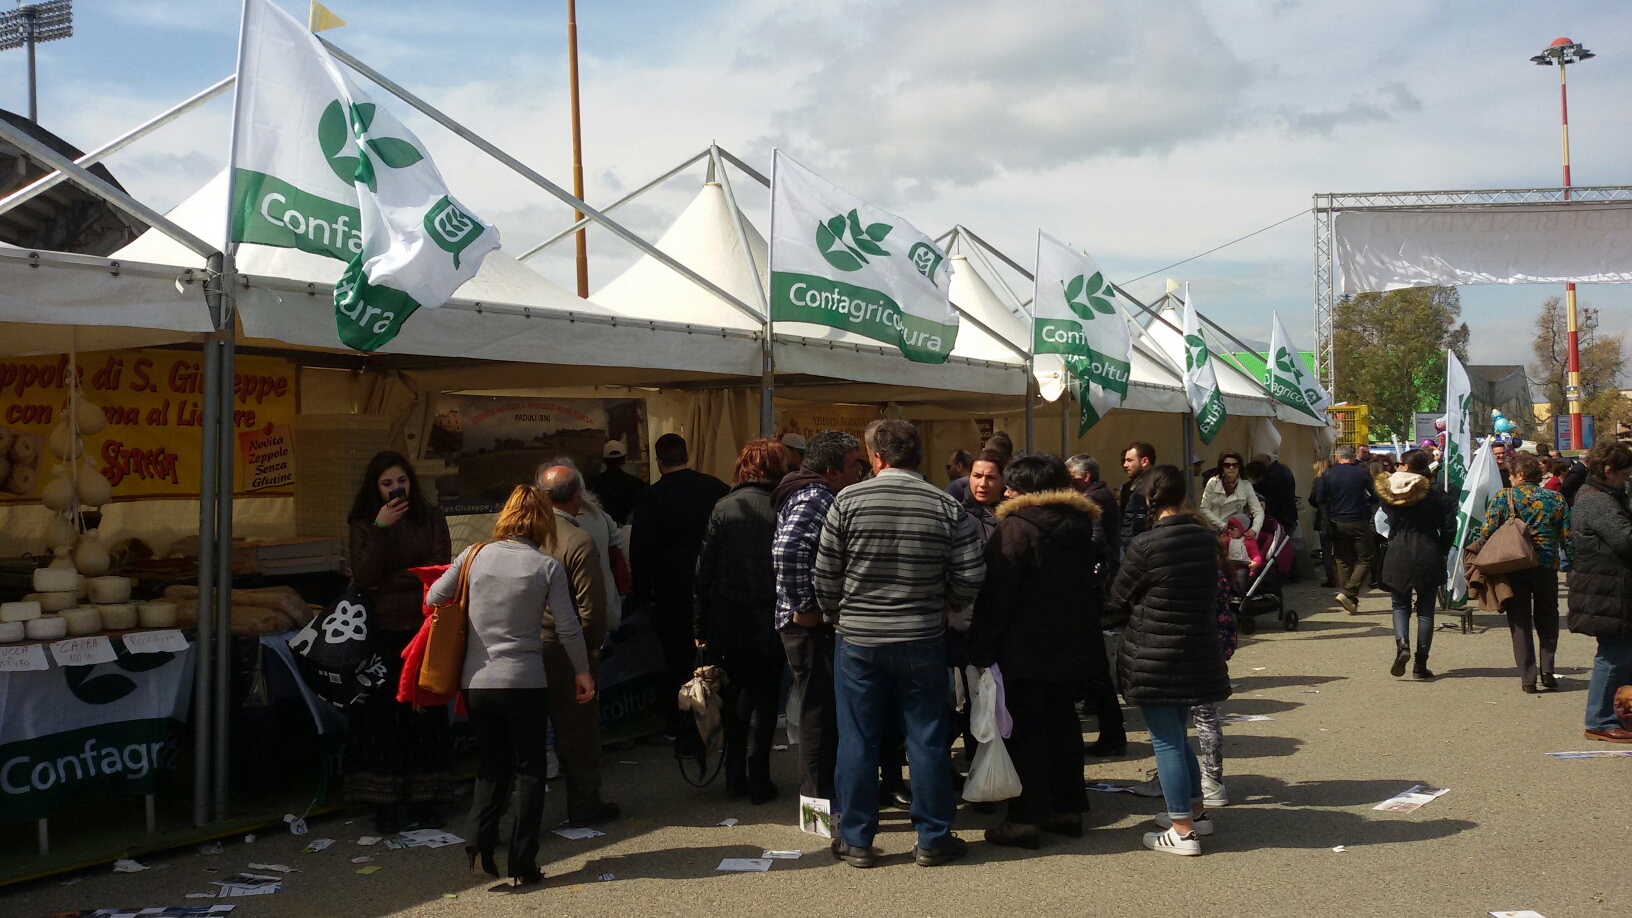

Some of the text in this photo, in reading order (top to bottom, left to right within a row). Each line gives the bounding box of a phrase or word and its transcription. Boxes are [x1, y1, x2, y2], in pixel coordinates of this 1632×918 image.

[91, 355, 124, 391] di
[130, 357, 158, 393] S.
[168, 359, 288, 404] Gieppe
[5, 403, 53, 425] con
[146, 398, 171, 426] al
[177, 400, 256, 428] Lire
[249, 435, 284, 452] Novità
[248, 446, 289, 465] Zeppole
[255, 462, 288, 476] Senza
[252, 473, 292, 488] Glutine
